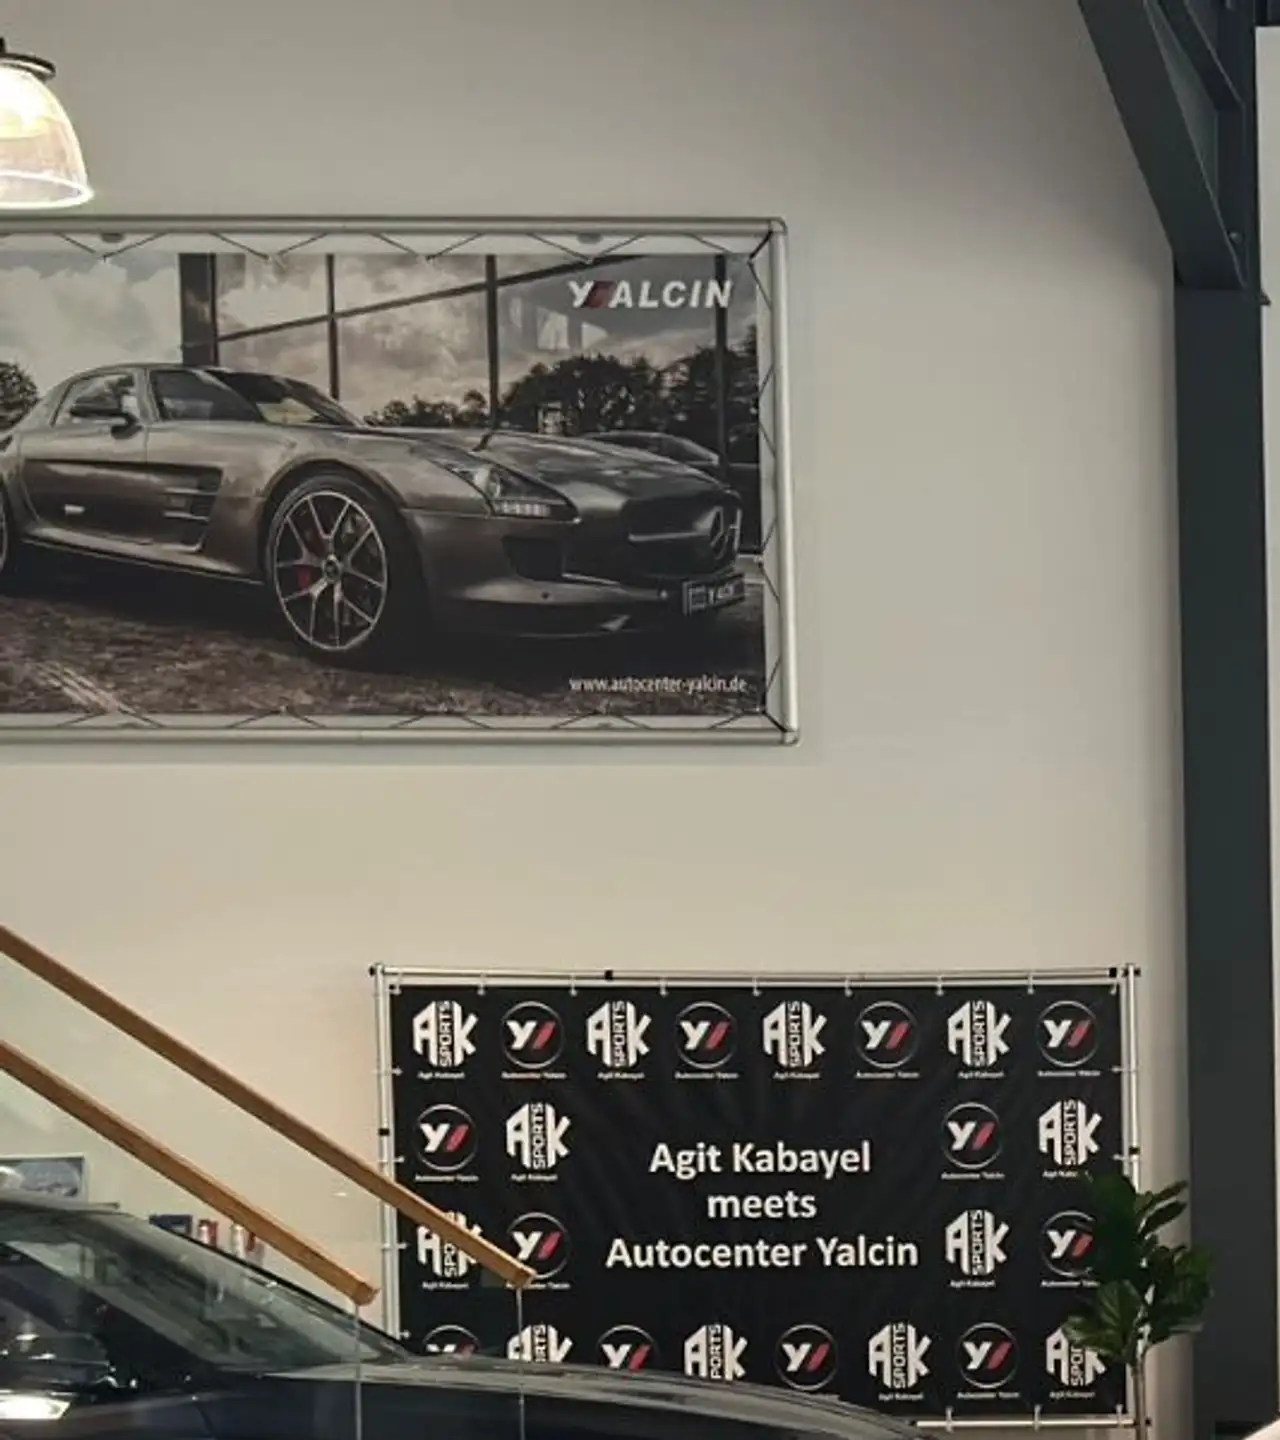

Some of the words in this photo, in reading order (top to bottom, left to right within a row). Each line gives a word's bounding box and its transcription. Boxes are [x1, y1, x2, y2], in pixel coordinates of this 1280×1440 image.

[649, 1142, 721, 1179] Agit
[733, 1140, 871, 1179] Kabayel
[708, 1191, 817, 1218] meets
[606, 1238, 807, 1268] Autocenter
[816, 1235, 918, 1267] Yalcin
